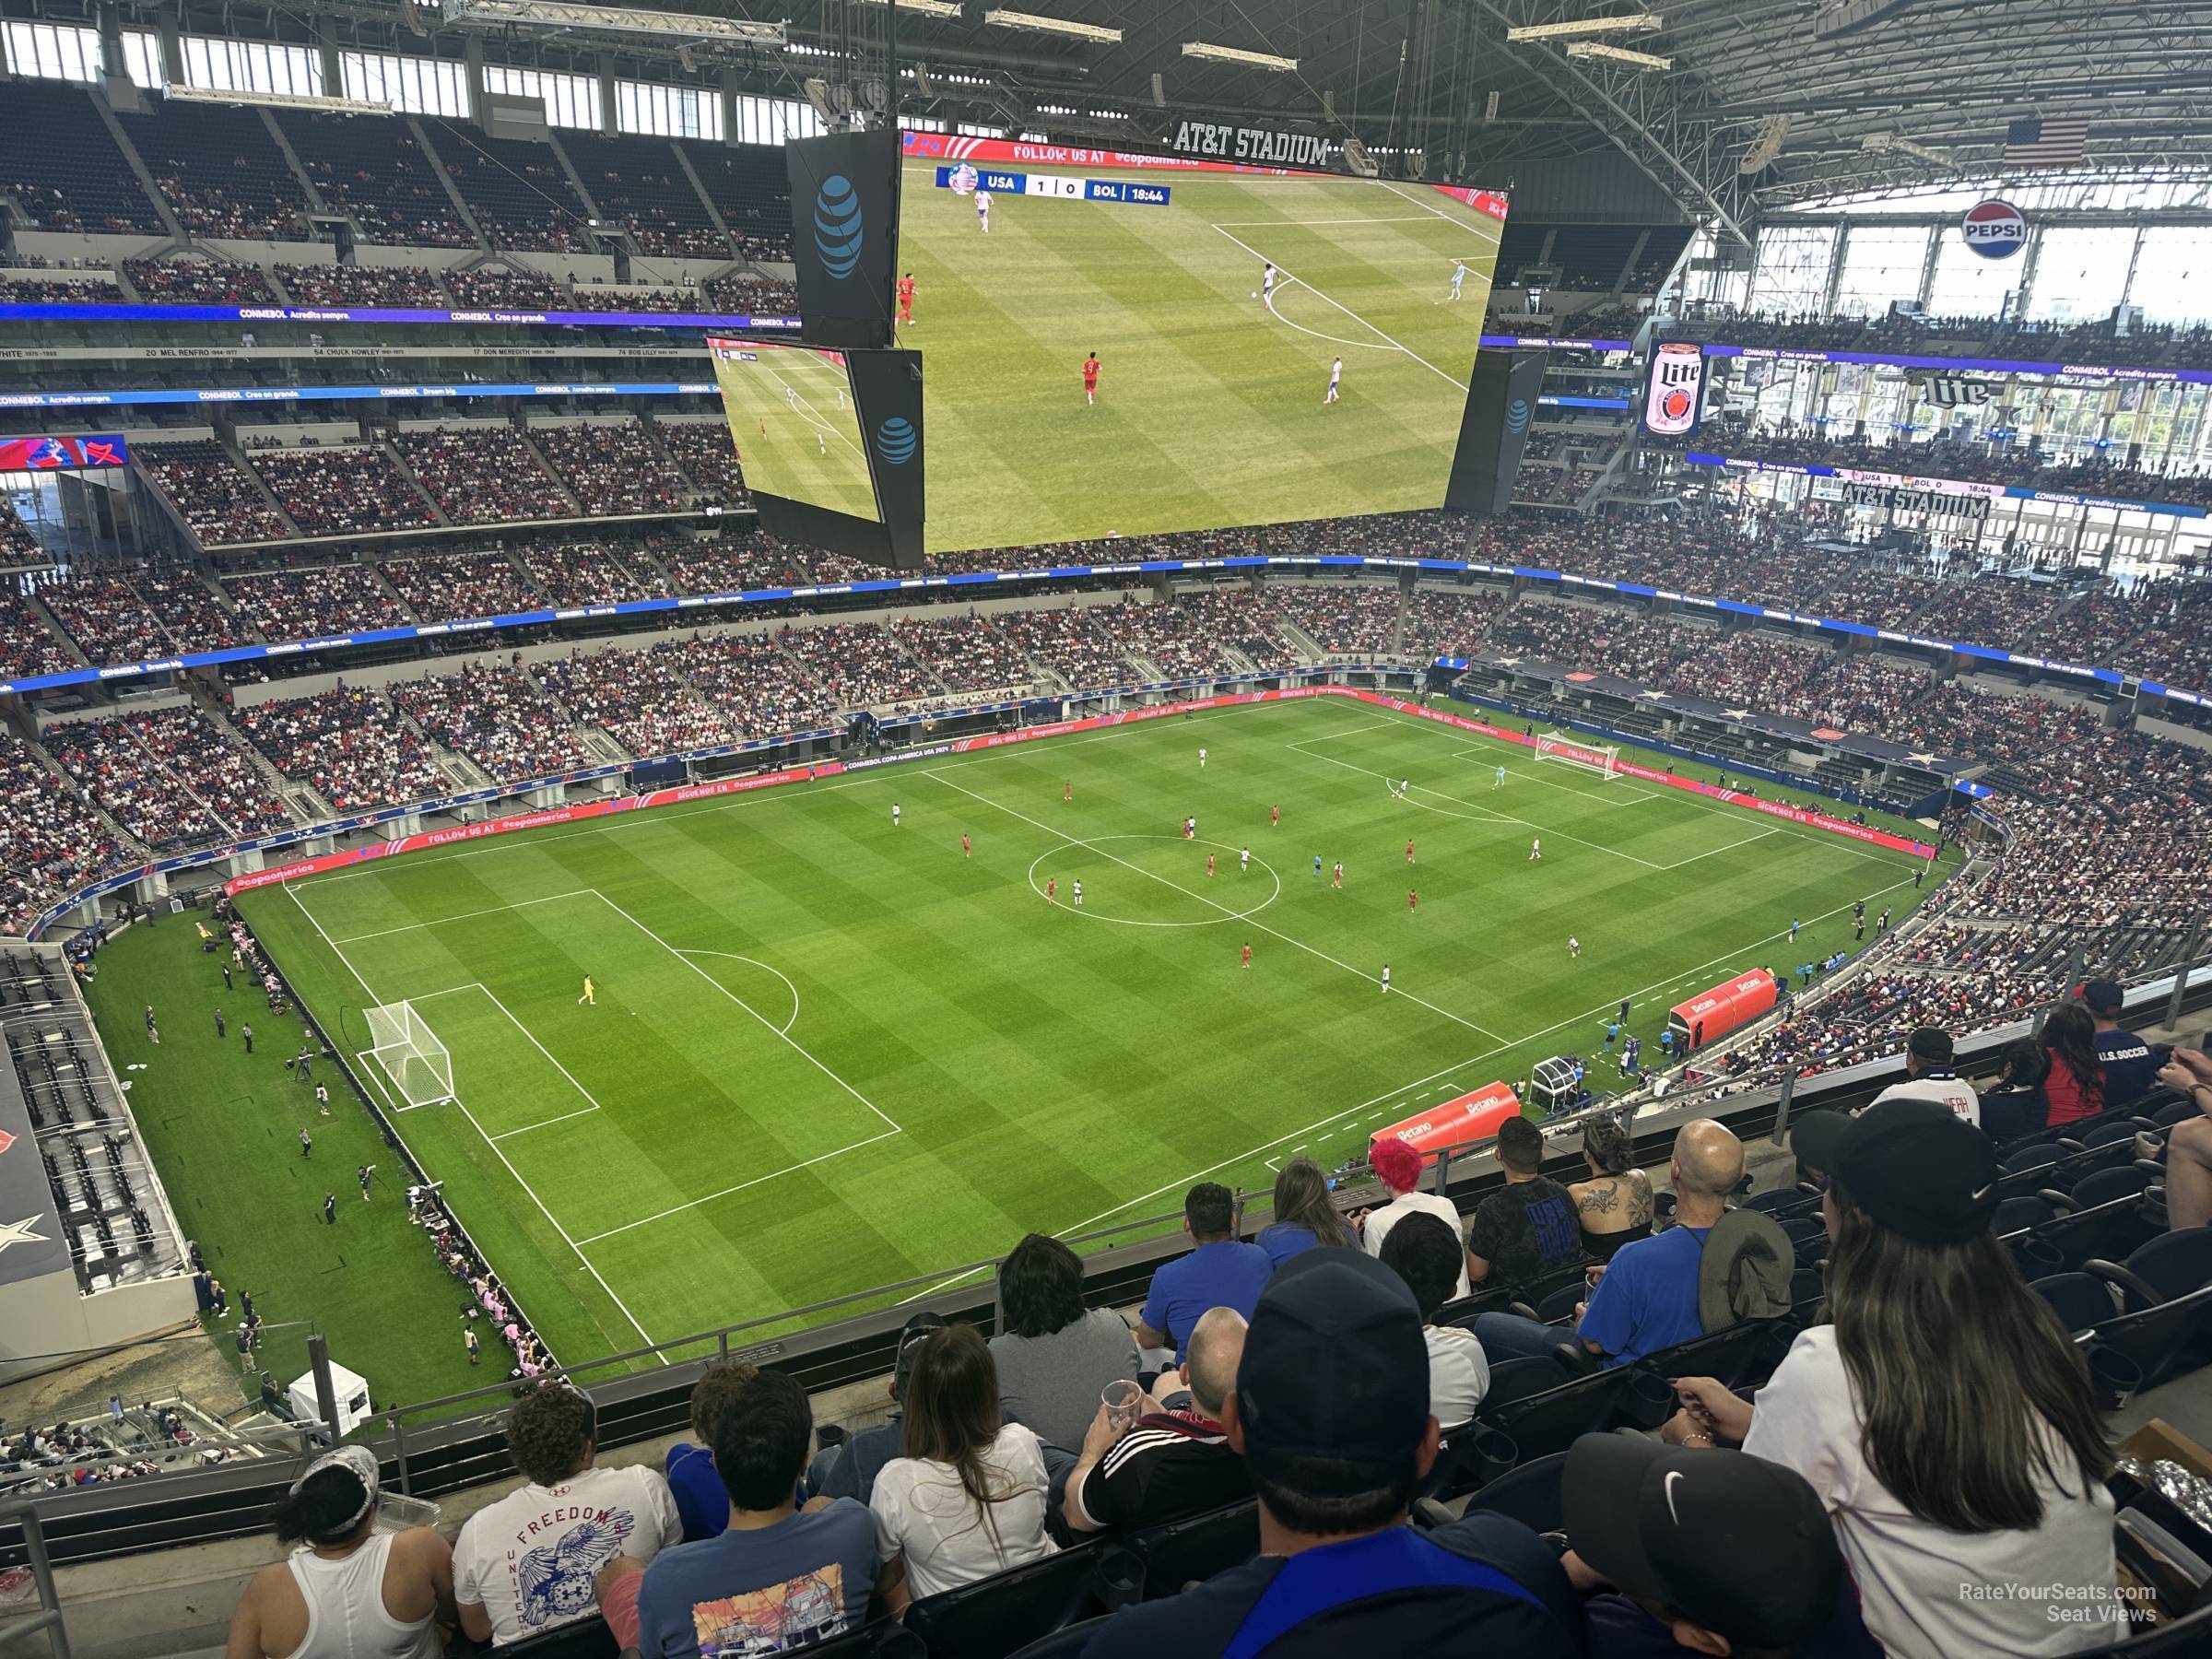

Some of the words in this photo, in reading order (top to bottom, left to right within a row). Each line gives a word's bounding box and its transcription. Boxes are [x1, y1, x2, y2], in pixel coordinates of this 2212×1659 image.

[1173, 121, 1232, 155] AT&T
[1235, 128, 1330, 166] STADIUM
[1014, 145, 1066, 162] FOLLOW
[1071, 149, 1087, 162] US
[1090, 151, 1105, 163] AT
[988, 175, 1015, 190] USA
[1038, 181, 1044, 192] 1
[1066, 183, 1076, 194] 0
[1093, 184, 1117, 198] BOL
[1132, 188, 1163, 202] 18:44
[1966, 224, 2022, 237] PEPSI
[240, 309, 288, 319] CONMEBOL
[451, 312, 492, 322] CONMEBOL
[495, 313, 510, 322] Cree
[750, 318, 785, 326] CONMEBOL
[1518, 338, 1549, 347] CONMEBOL
[179, 348, 209, 357] RENFRO
[1743, 348, 1778, 358] CONMEBOL
[1781, 350, 1794, 359] Cree
[1661, 362, 1700, 387] Lite
[2063, 365, 2110, 376] CONMEBOL
[198, 391, 242, 400] CONMEBOL
[423, 387, 445, 395] Dream
[1924, 376, 1990, 409] Lite
[1726, 458, 1759, 468] CONMEBOL
[1865, 473, 1881, 482] USA
[1914, 478, 1931, 488] BOL
[1969, 485, 1992, 494] 18:44
[1842, 485, 1889, 507] AT&T
[1893, 490, 1990, 520] STADIUM
[2035, 492, 2079, 504] CONMEBOL
[100, 665, 143, 677] CONMEBOL
[848, 757, 882, 770] CONMEBOL
[882, 754, 898, 764] COPA
[924, 748, 935, 758] USA
[935, 746, 948, 755] 2024
[734, 773, 791, 790] @copaamerica
[428, 830, 467, 844] FOLLOW
[469, 826, 481, 837] US
[483, 824, 495, 834] AT
[502, 811, 571, 829] @copaamerica
[1812, 817, 1874, 840] @copaamerica
[236, 863, 315, 888] @copaamerica
[1736, 978, 1761, 993] Betano
[1691, 998, 1716, 1014] Betano
[2098, 1051, 2117, 1062] U.S.
[2117, 1046, 2149, 1060] SOCCER
[1465, 1095, 1499, 1114] Betano
[1943, 1096, 1970, 1113] WEAH
[1397, 1122, 1432, 1141] Betano
[516, 1506, 610, 1545] FREEDOM
[507, 1549, 524, 1624] UNITED
